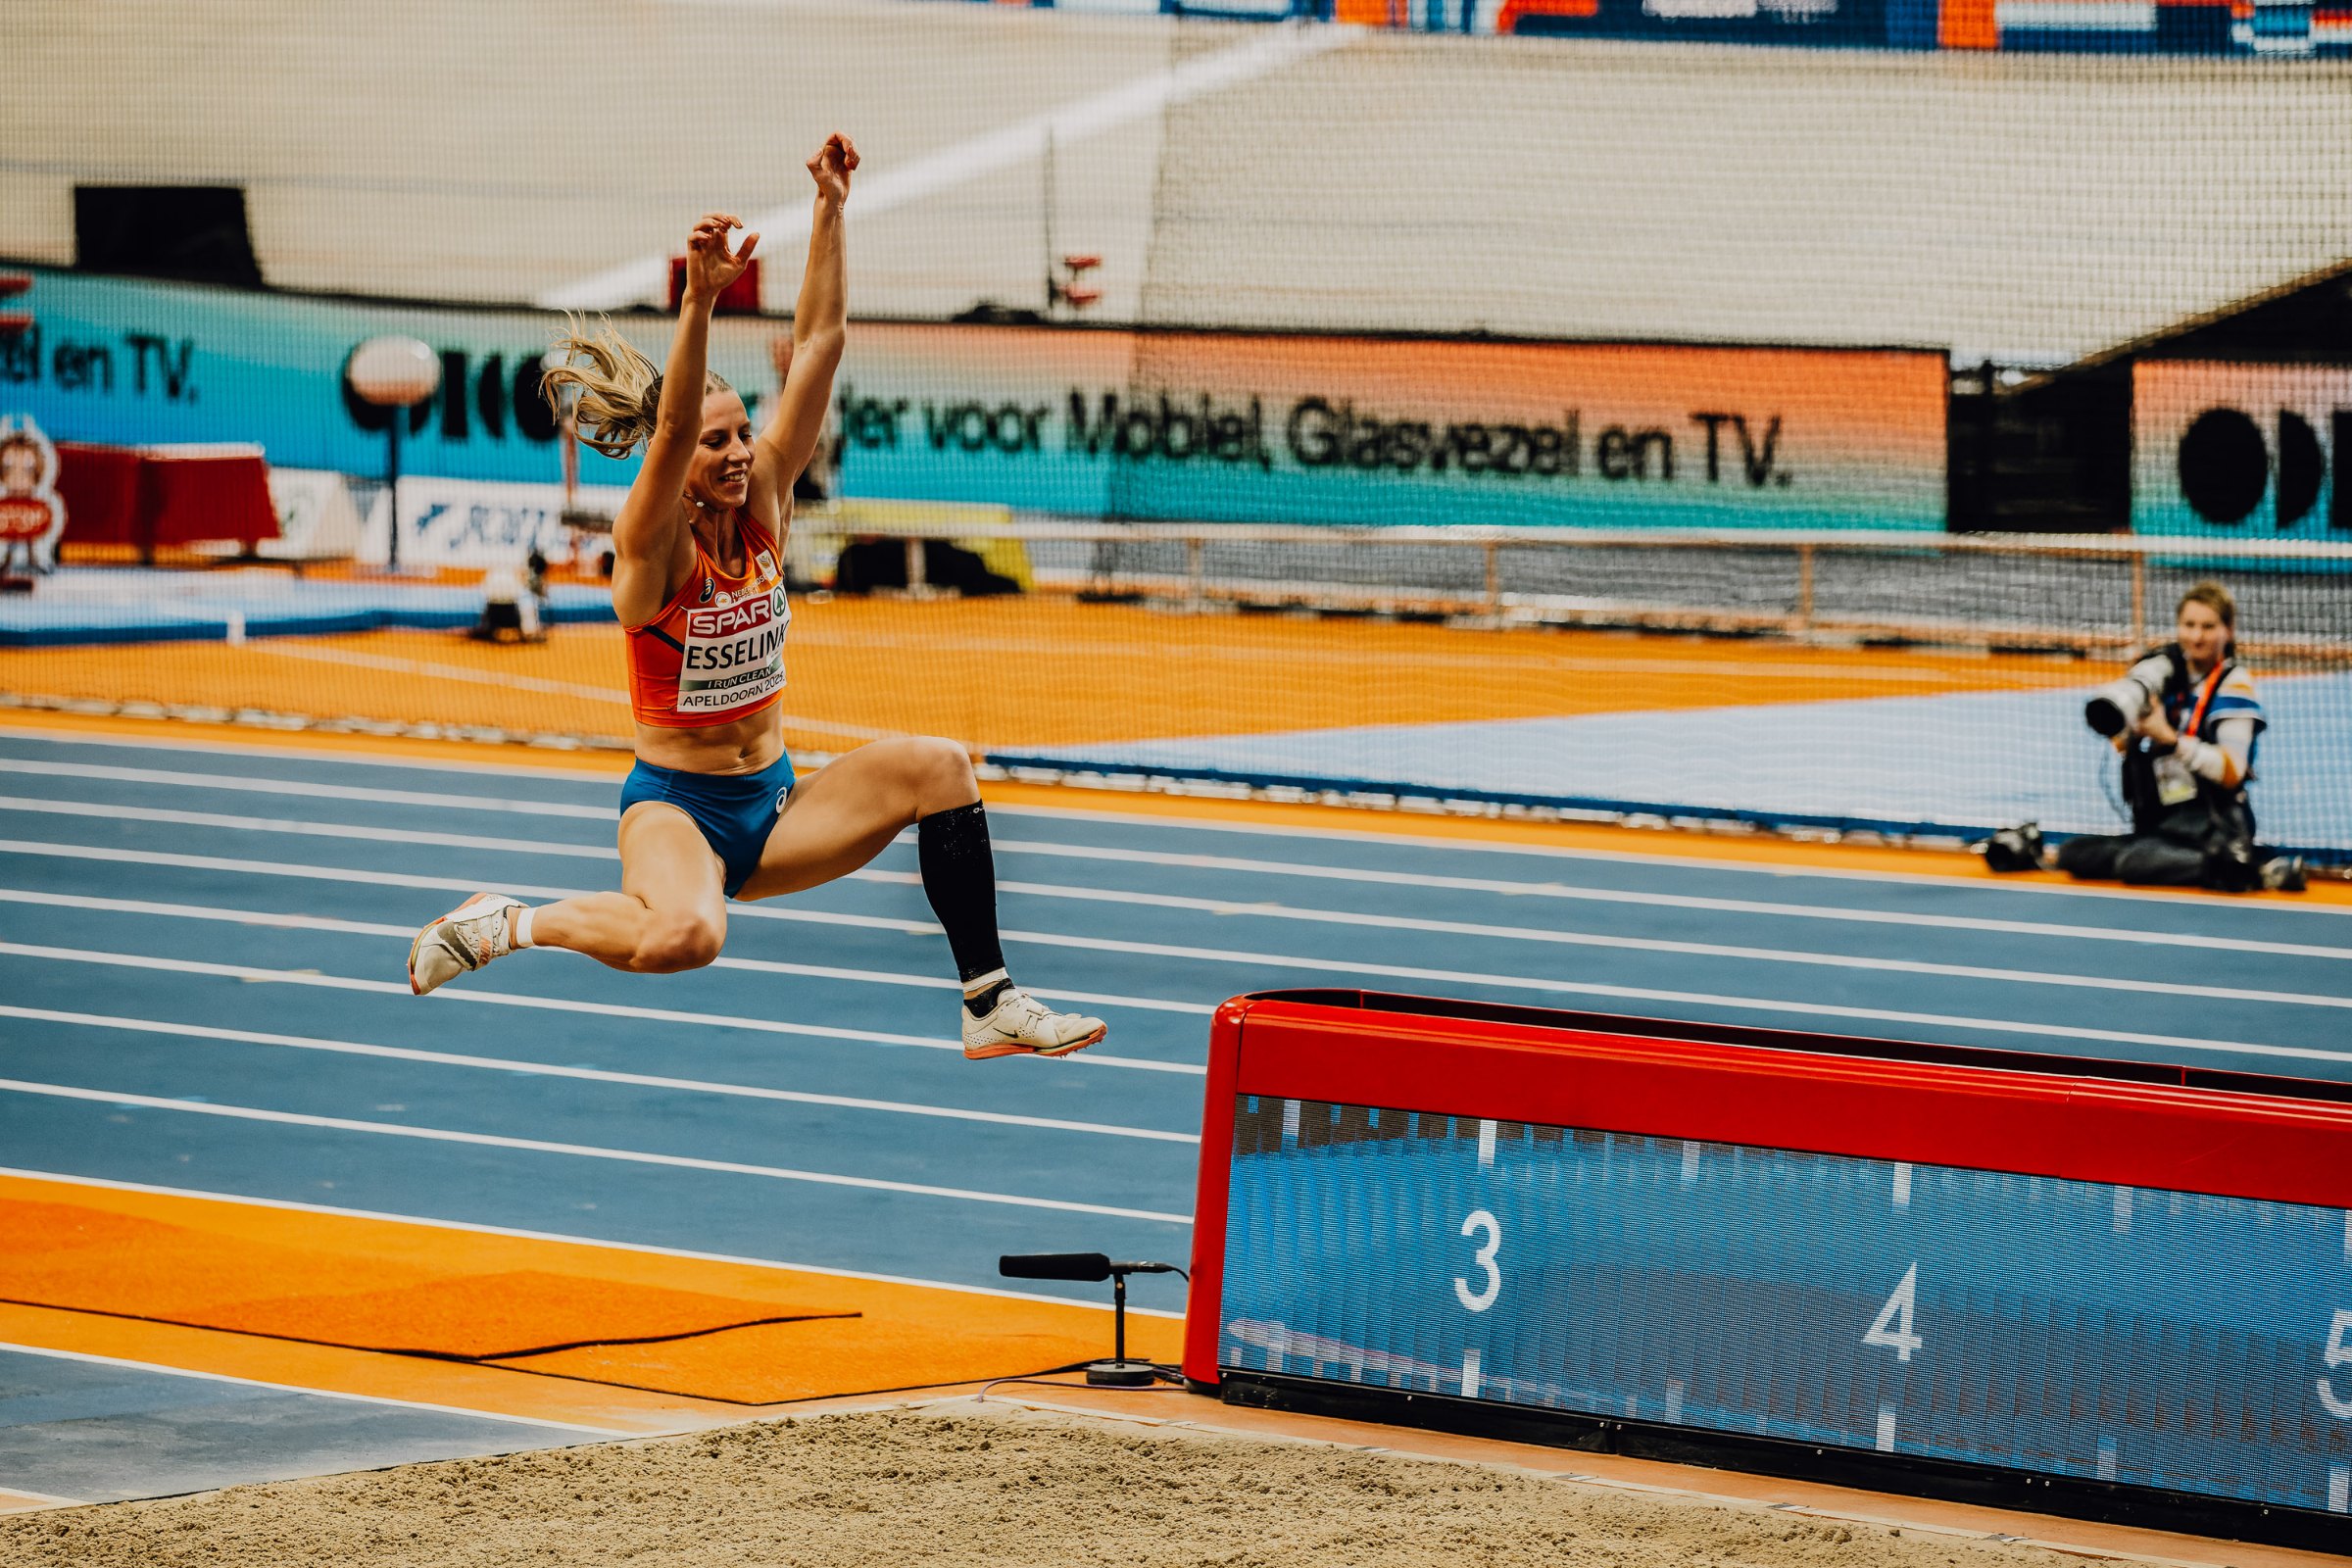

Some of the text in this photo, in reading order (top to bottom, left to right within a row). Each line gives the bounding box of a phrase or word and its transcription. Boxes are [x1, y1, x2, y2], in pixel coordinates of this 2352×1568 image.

[922, 396, 1049, 453] voor
[1287, 395, 1581, 477] Glasvezel
[1596, 422, 1674, 482] en
[1688, 409, 1792, 488] TV.
[686, 619, 789, 670] ESSELINK
[692, 599, 770, 635] SPAR
[683, 685, 763, 707] APELDOORN
[713, 678, 737, 689] RUN
[739, 667, 771, 684] CLEAN
[1454, 1209, 1501, 1312] 3
[1862, 1261, 1923, 1360] 4
[2316, 1309, 2352, 1418] 5
